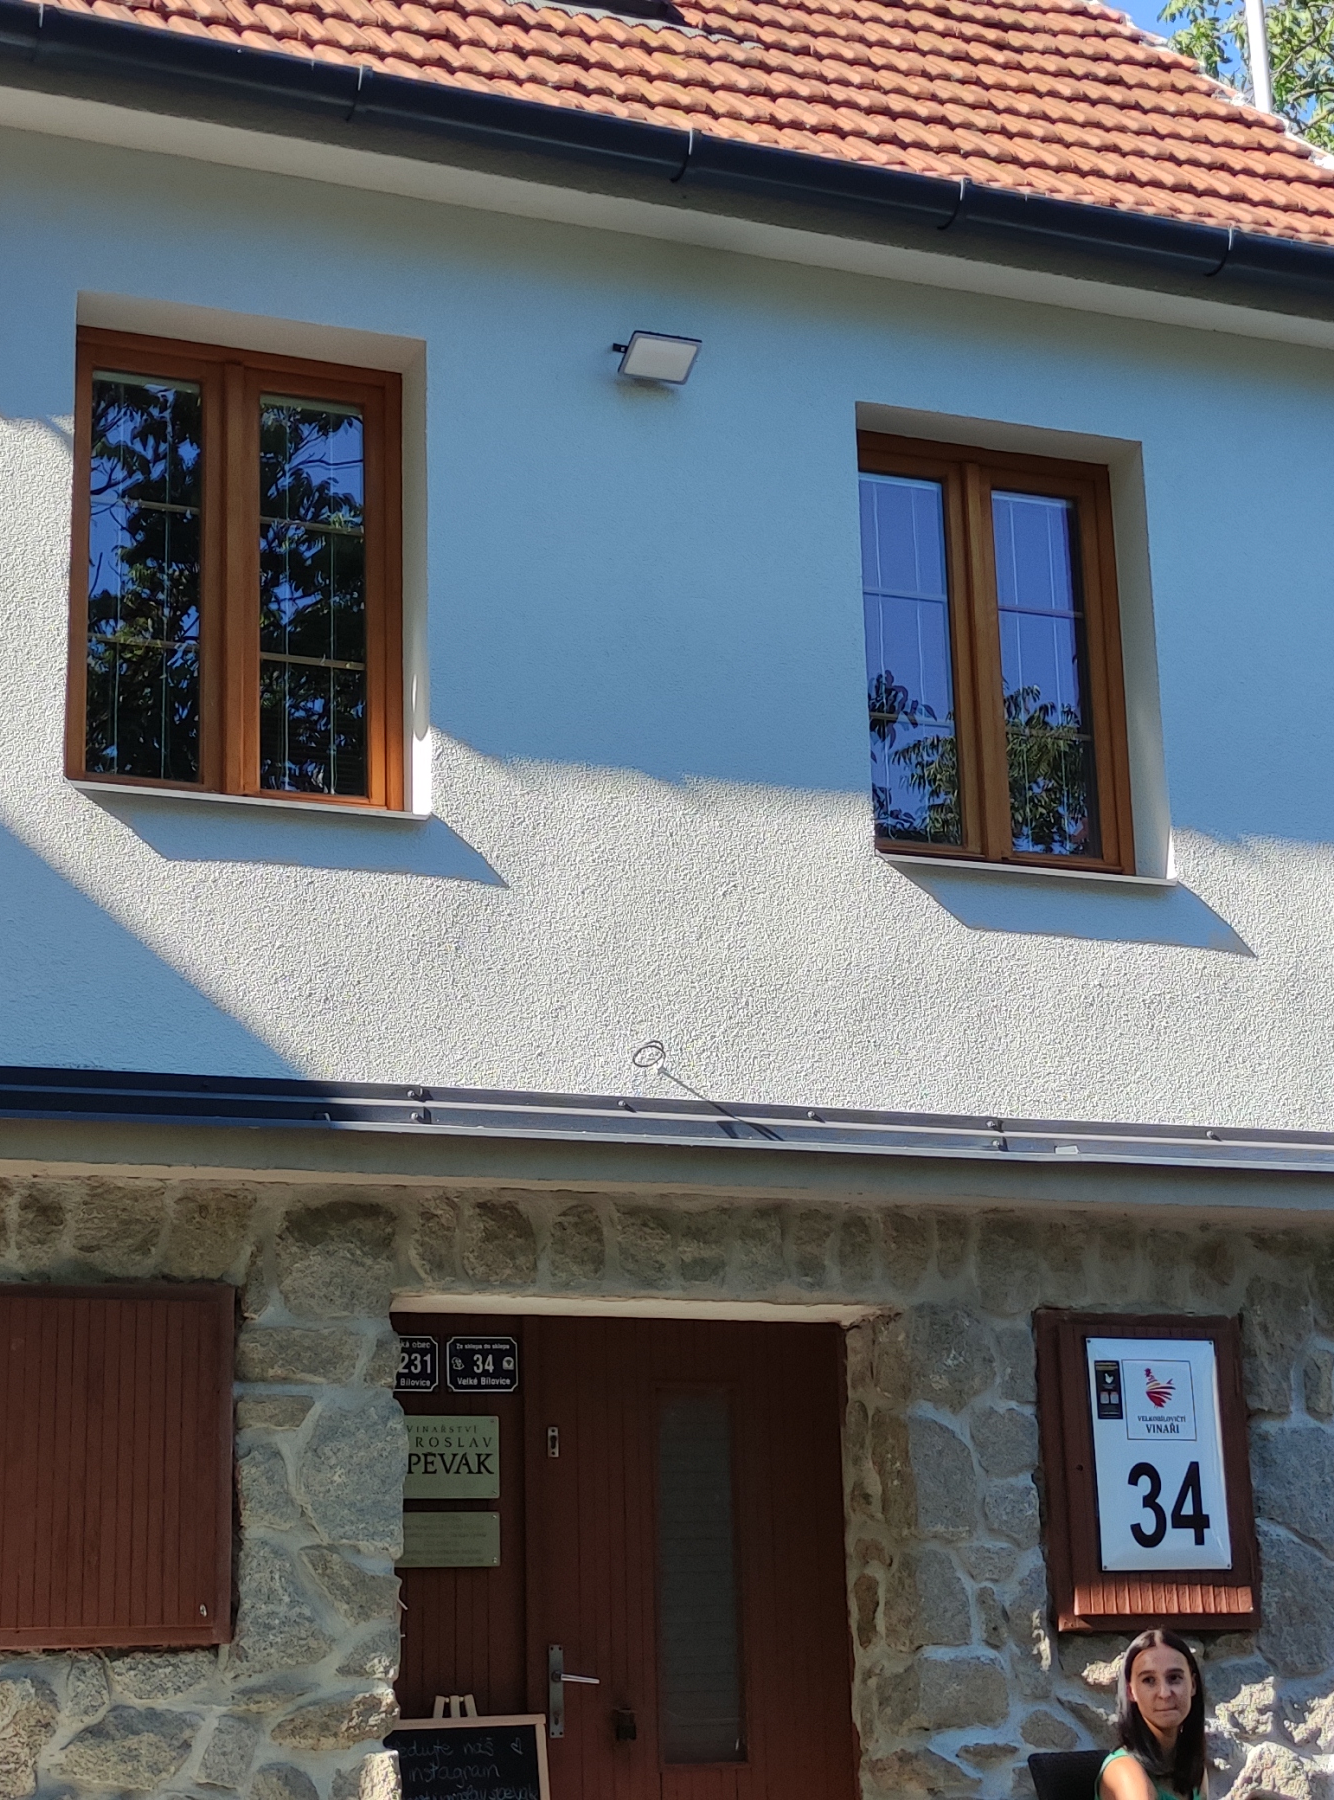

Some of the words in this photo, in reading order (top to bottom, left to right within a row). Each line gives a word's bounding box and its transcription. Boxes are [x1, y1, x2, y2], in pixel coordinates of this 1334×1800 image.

[473, 1354, 495, 1373] 34
[457, 1376, 478, 1386] Velké
[406, 1424, 478, 1434] VINAŘSTVÍ
[1145, 1423, 1180, 1434] VINAŘI
[415, 1436, 492, 1448] ROSLAV
[407, 1451, 495, 1475] PĚVÁK
[1127, 1461, 1211, 1549] 34
